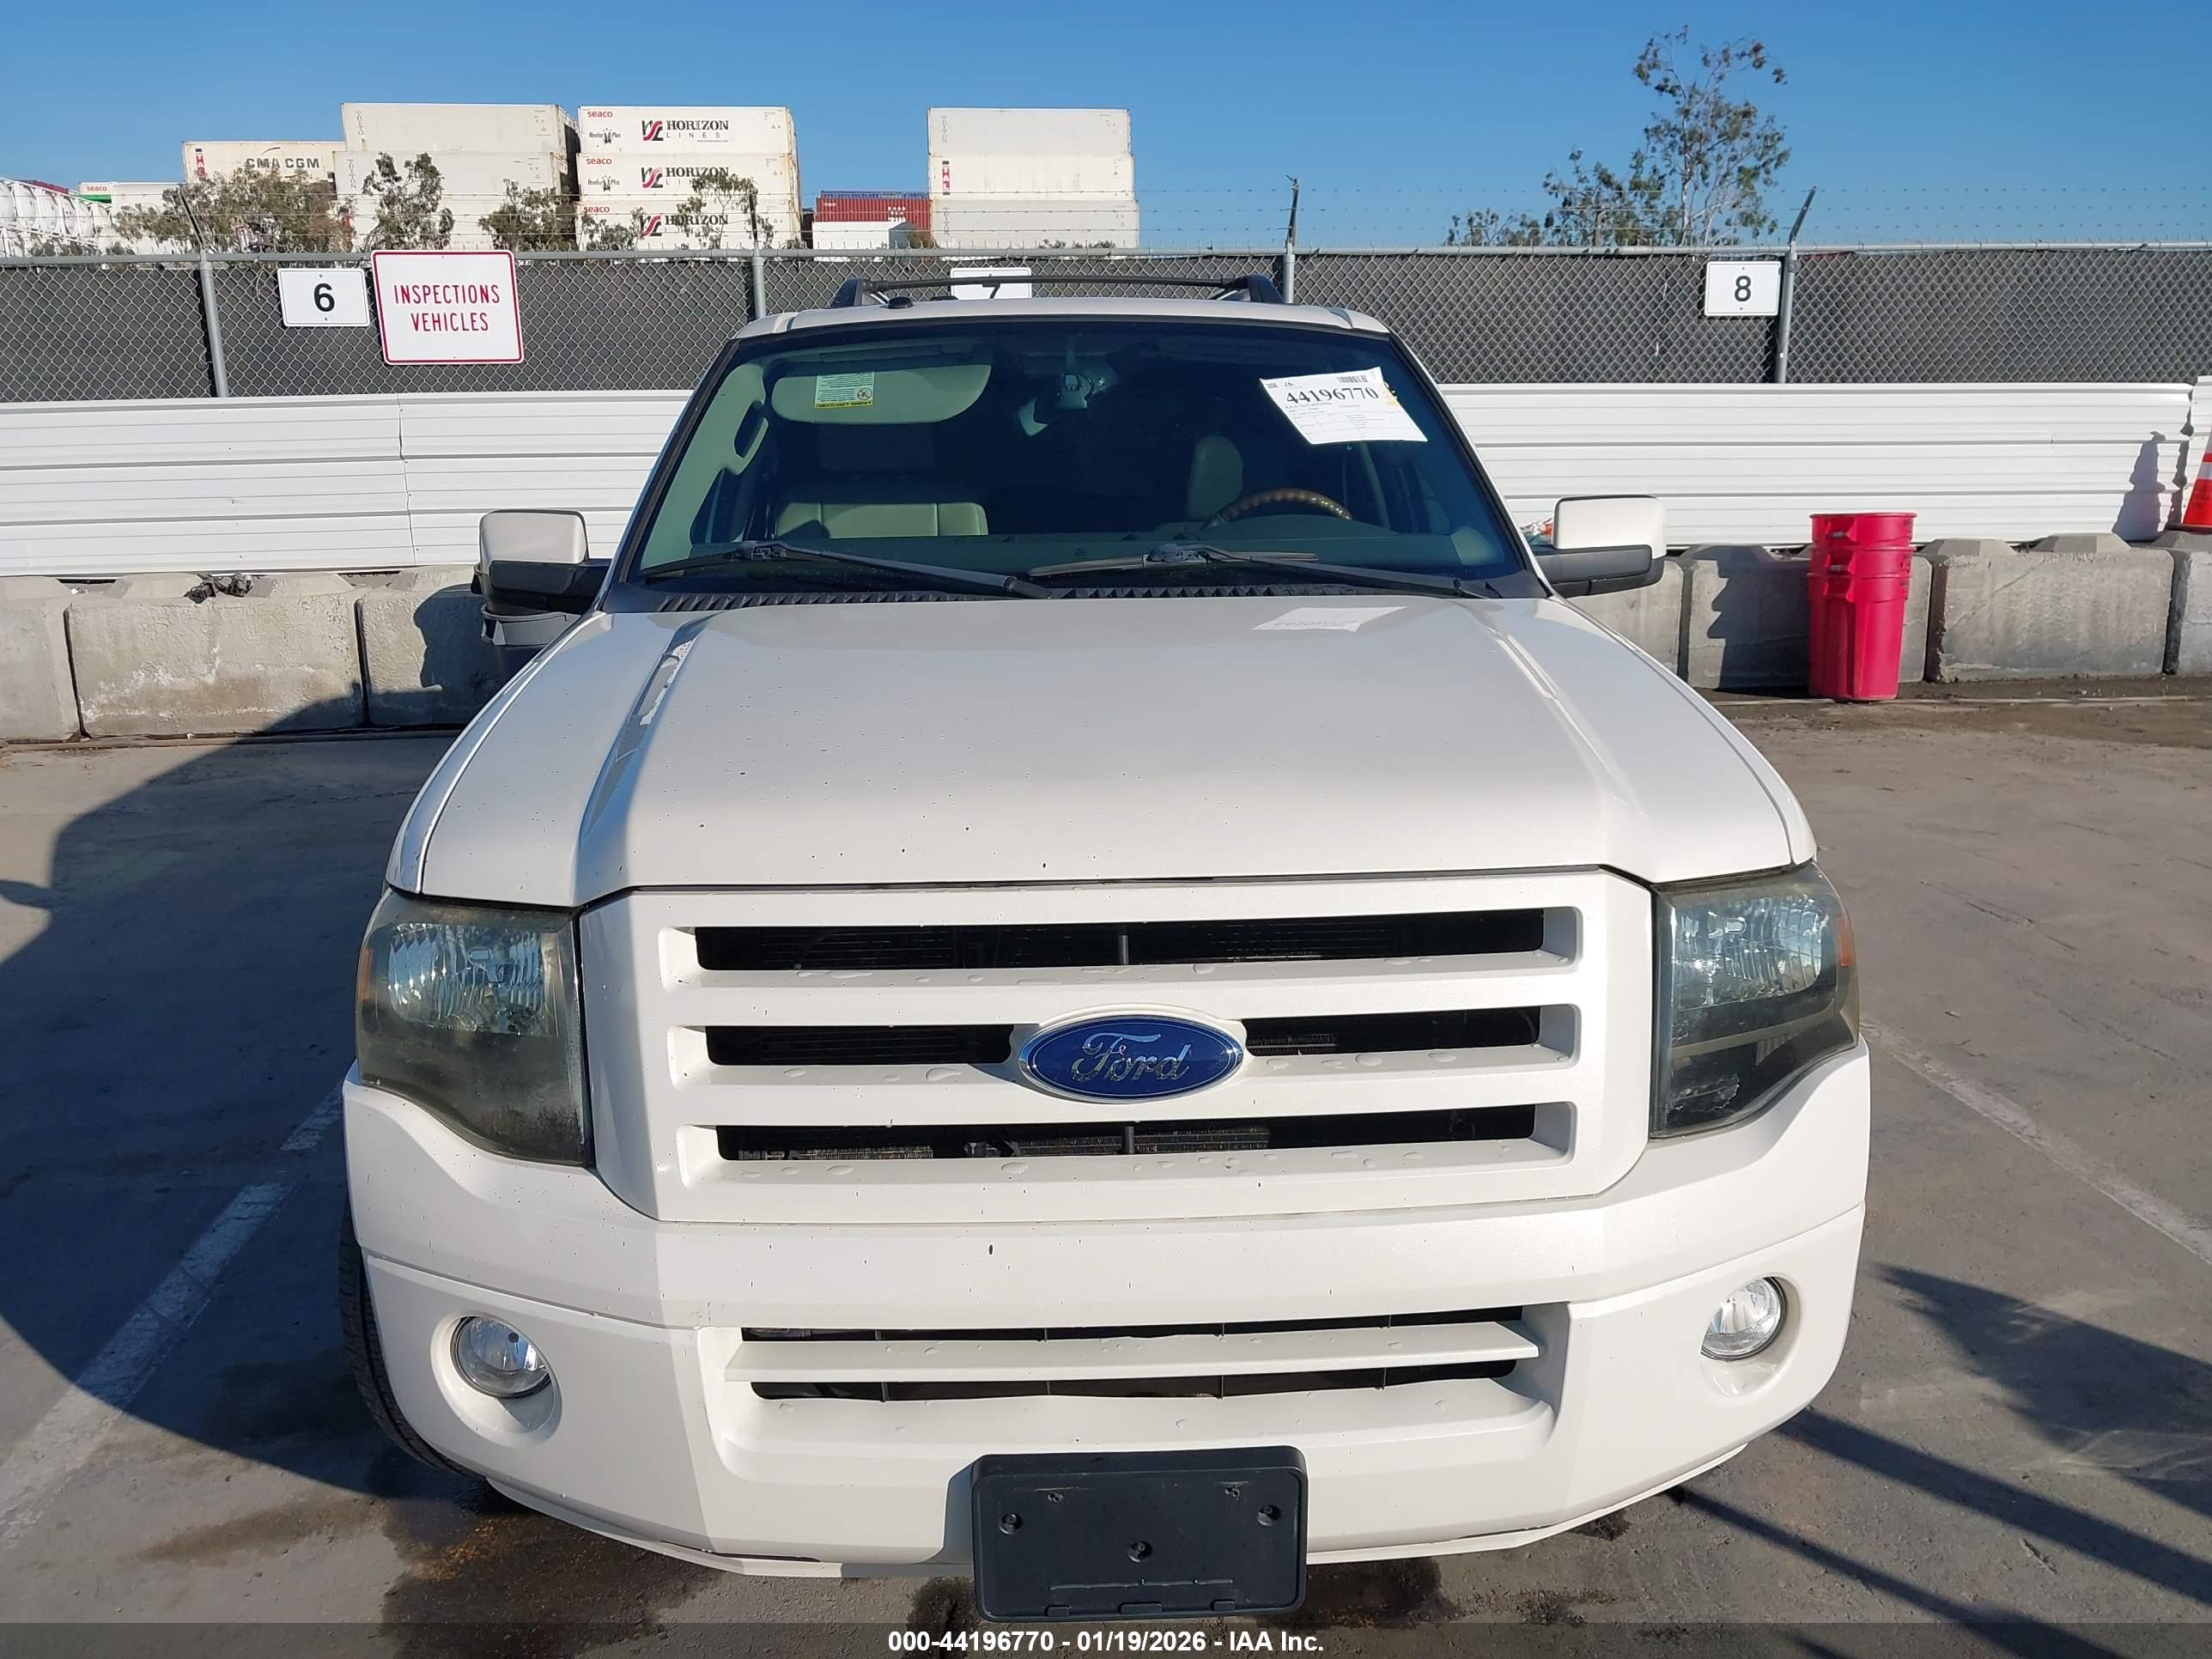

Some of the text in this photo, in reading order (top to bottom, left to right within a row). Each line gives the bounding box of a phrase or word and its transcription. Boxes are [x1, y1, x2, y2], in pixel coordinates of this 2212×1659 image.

[666, 120, 729, 131] HORIZON
[246, 158, 319, 168] CMA CGM
[665, 167, 729, 177] HORIZON
[665, 215, 729, 225] HORIZON
[313, 283, 336, 312] 6
[393, 284, 501, 305] INSPECTIONS
[1734, 275, 1752, 302] 8
[410, 312, 489, 331] VEHICLES
[1286, 386, 1379, 404] 44196770
[1072, 1032, 1192, 1082] Ford
